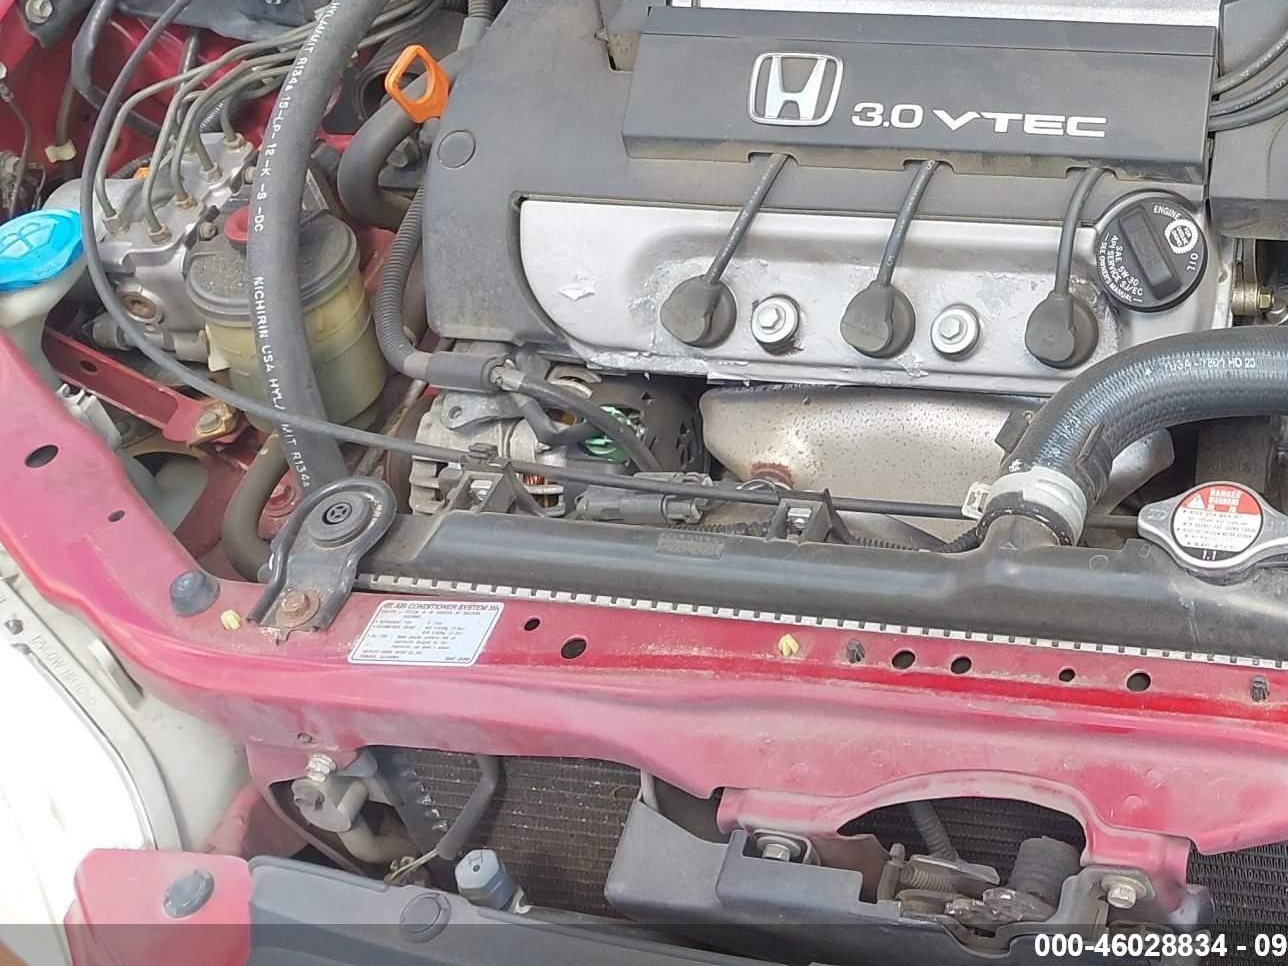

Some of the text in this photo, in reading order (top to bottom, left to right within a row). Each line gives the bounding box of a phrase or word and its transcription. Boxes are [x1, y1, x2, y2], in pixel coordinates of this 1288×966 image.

[851, 101, 925, 130] 3.0
[932, 107, 1109, 138] VTEC
[1153, 205, 1182, 219] ENGINE
[1115, 243, 1124, 263] SAE
[1186, 252, 1199, 271] OIL
[1107, 249, 1121, 282] SERVICE
[1109, 282, 1133, 302] MANUAL
[253, 275, 270, 338] NICHIRIN
[261, 344, 276, 373] USA
[290, 450, 312, 488] R134a
[1201, 549, 1217, 561] 1.1
[407, 603, 458, 611] CONDITIONER
